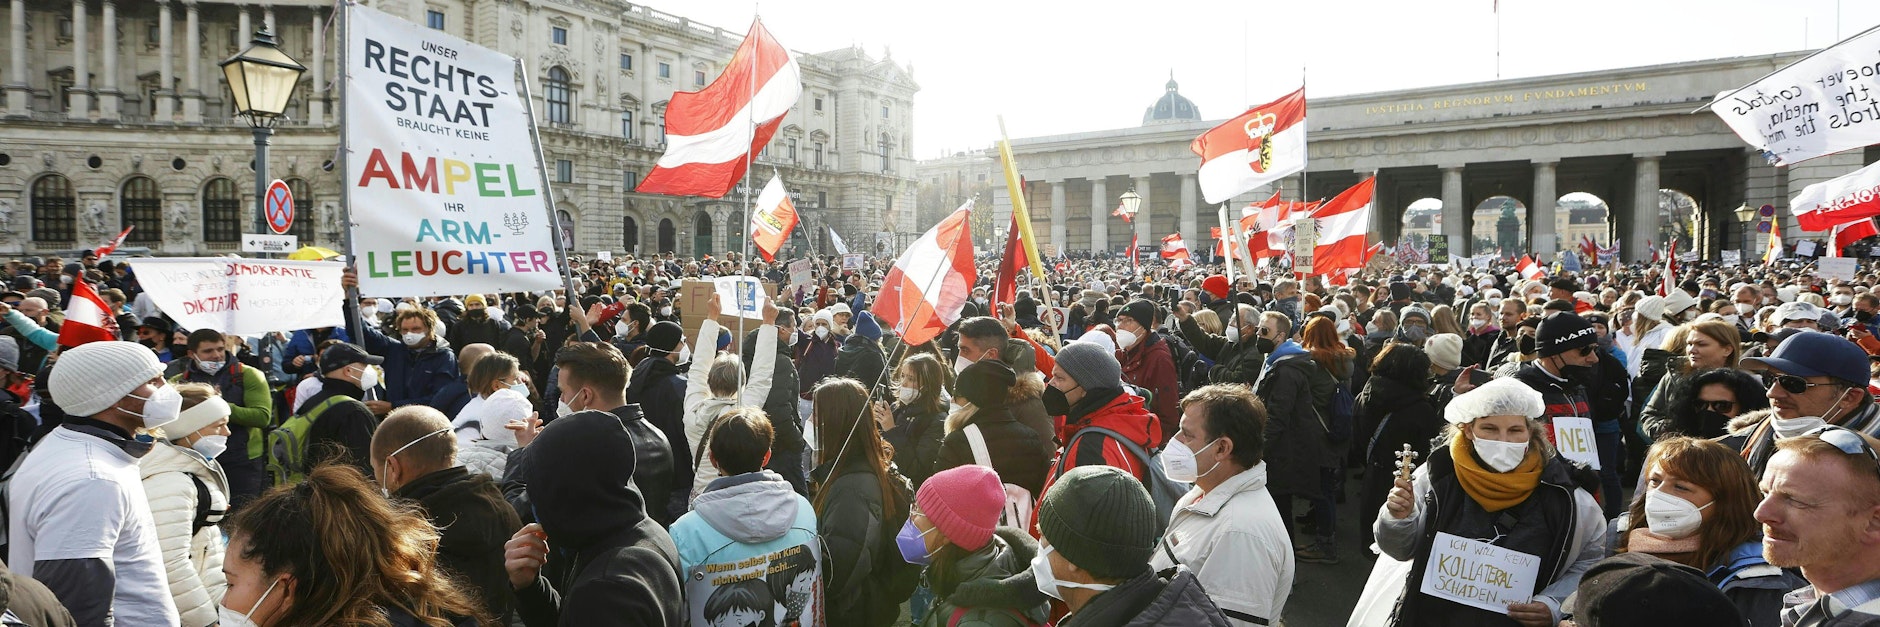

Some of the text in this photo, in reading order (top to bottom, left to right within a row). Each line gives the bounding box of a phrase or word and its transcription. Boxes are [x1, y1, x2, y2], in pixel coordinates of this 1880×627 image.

[421, 40, 458, 60] UNSER
[365, 38, 508, 98] RECHTS-
[385, 81, 494, 127] STAAT
[1366, 103, 1424, 115] IVSTITIA
[1433, 94, 1513, 110] REGNORVM
[397, 117, 490, 141] BRAUCHT KEINE
[358, 148, 536, 197] AMPEL
[444, 202, 465, 212] IHR
[416, 219, 501, 245] ARM-
[226, 263, 317, 279] DEMOKRATIE
[368, 250, 553, 278] LEUCHTER
[183, 293, 240, 315] DIKTATUR
[705, 545, 801, 574] Wenn selbst ein Kind
[1450, 539, 1468, 551] ICH
[1504, 552, 1532, 568] KEIN
[712, 574, 738, 586] nicht
[740, 569, 765, 582] mehr
[1438, 553, 1519, 589] KOLLATERAL-
[1434, 576, 1498, 604] SCHADEN
